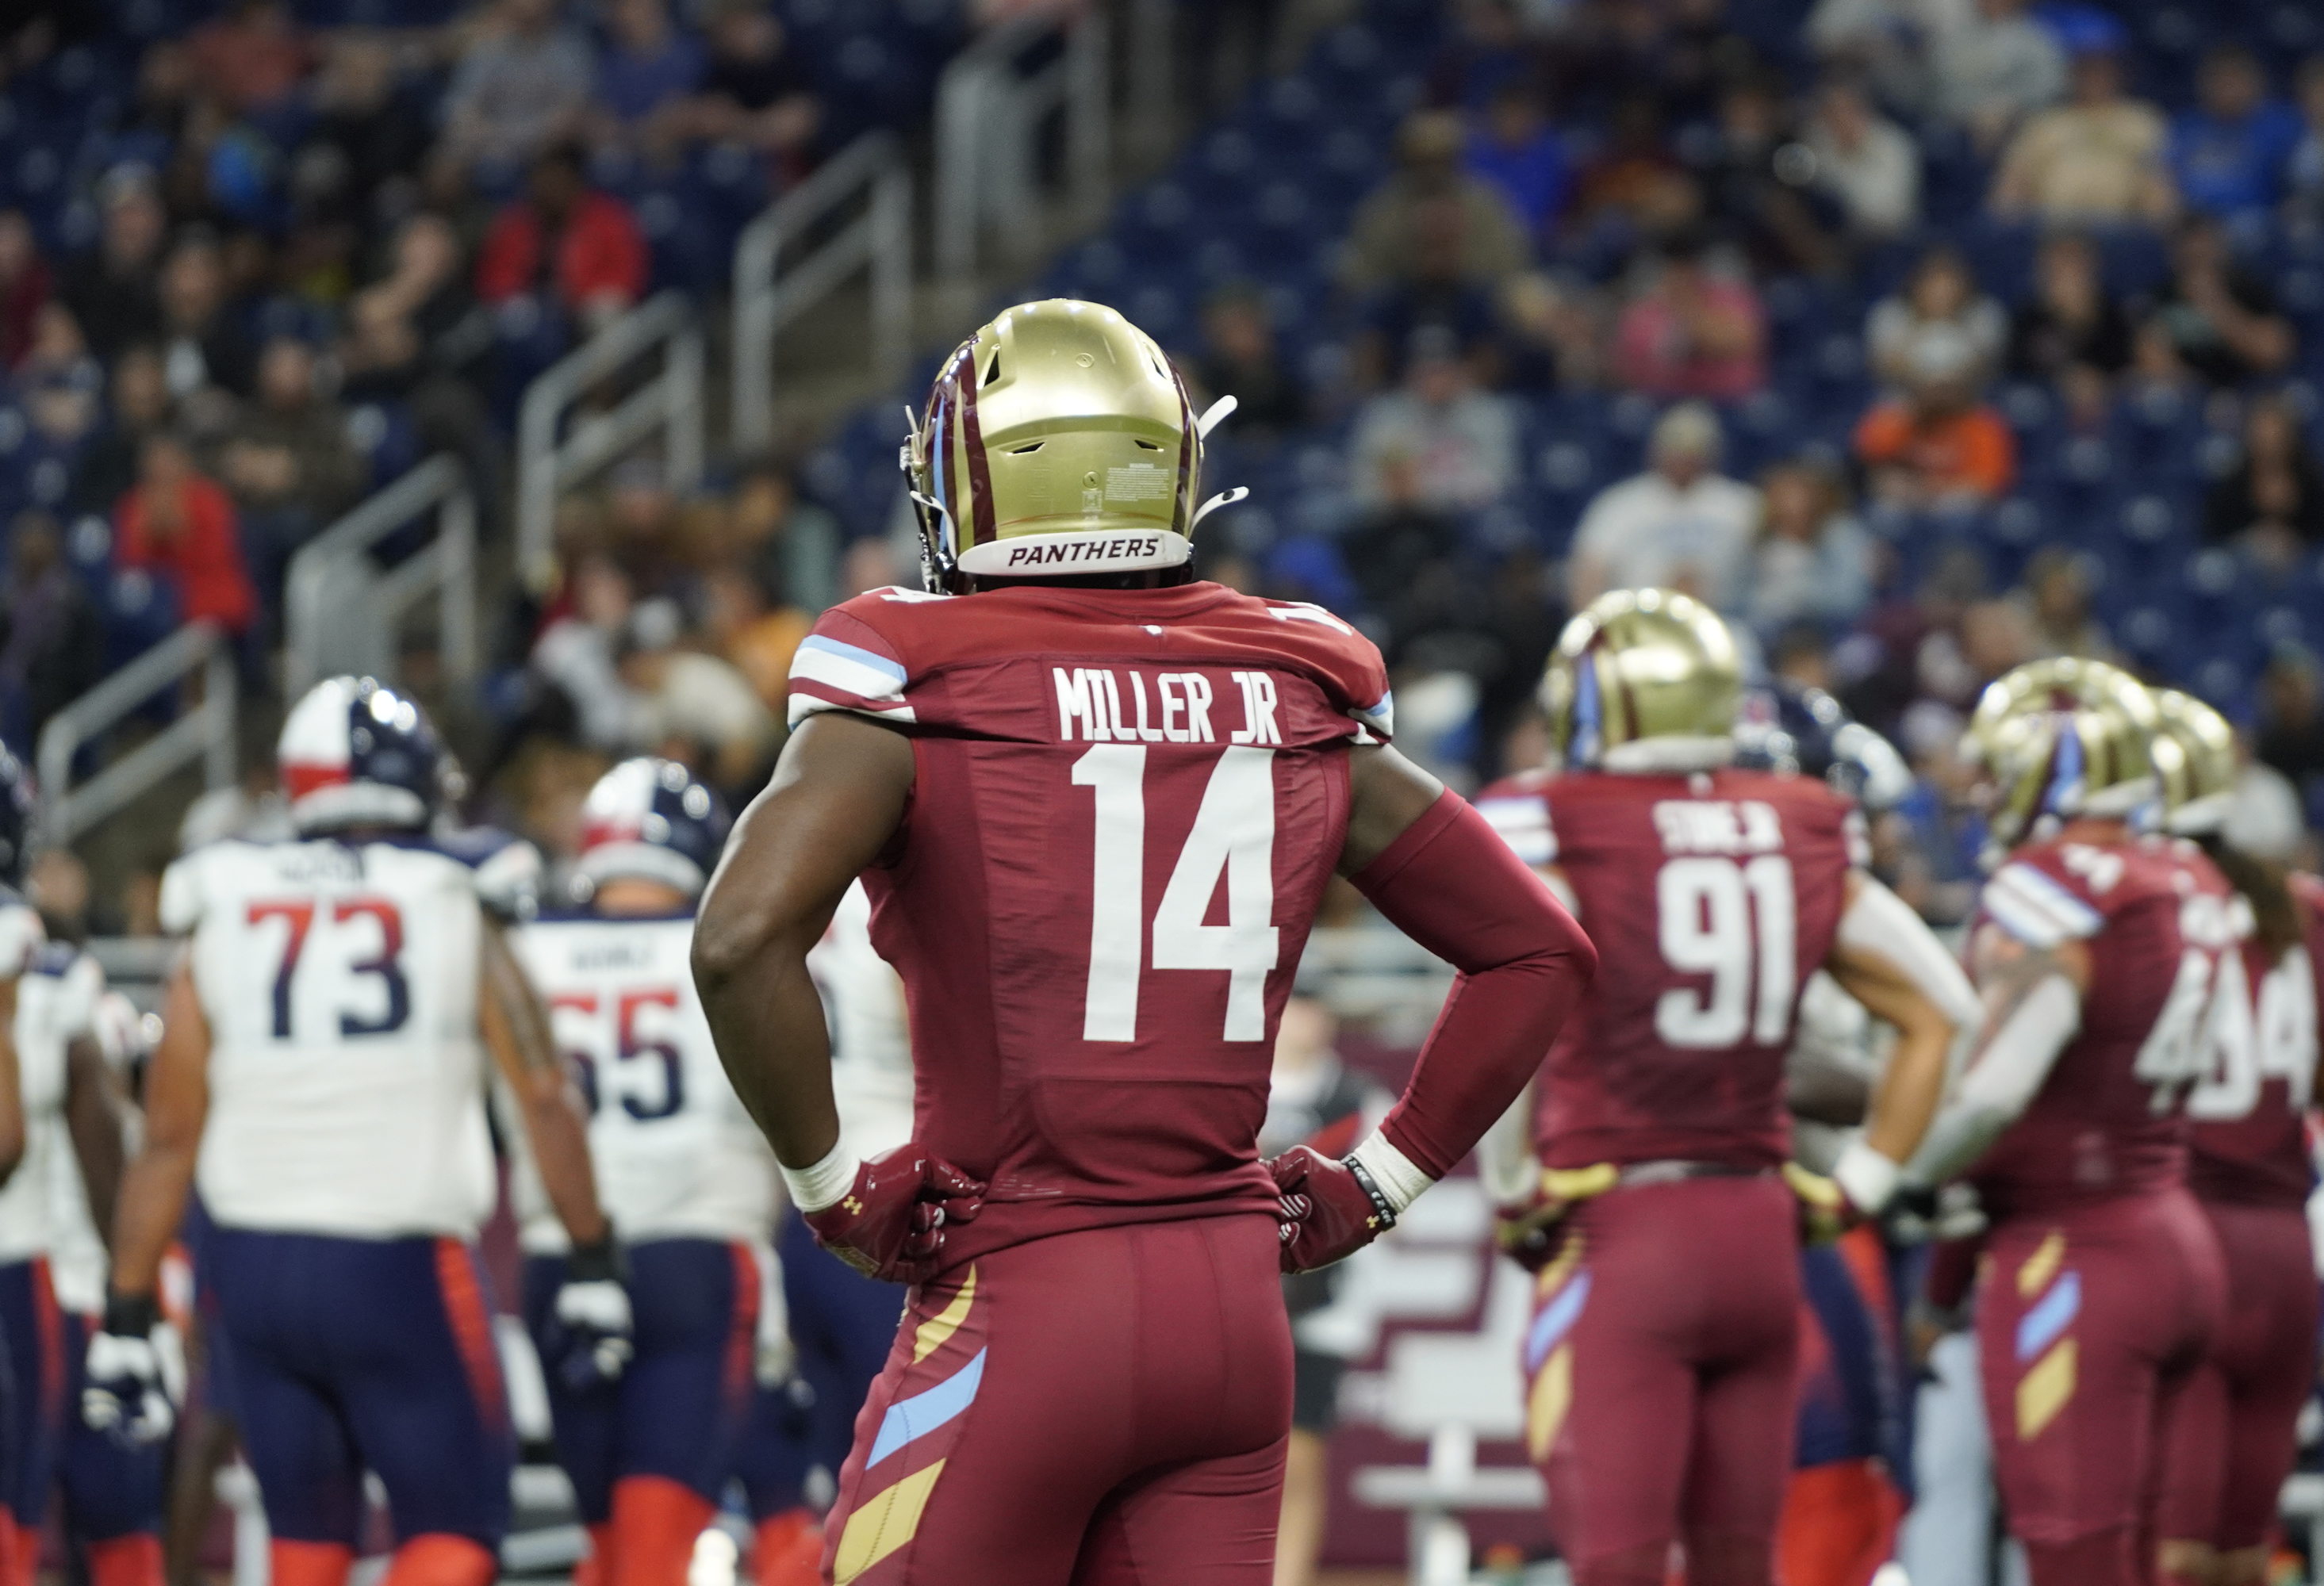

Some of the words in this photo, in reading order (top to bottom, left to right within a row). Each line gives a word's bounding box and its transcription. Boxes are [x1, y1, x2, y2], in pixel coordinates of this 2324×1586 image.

[1007, 538, 1160, 567] PANTHERS
[1053, 667, 1216, 743] MILLER
[1231, 671, 1283, 745] JR
[1072, 742, 1279, 1043] 14
[1654, 853, 1798, 1048] 91
[245, 896, 412, 1041] 73
